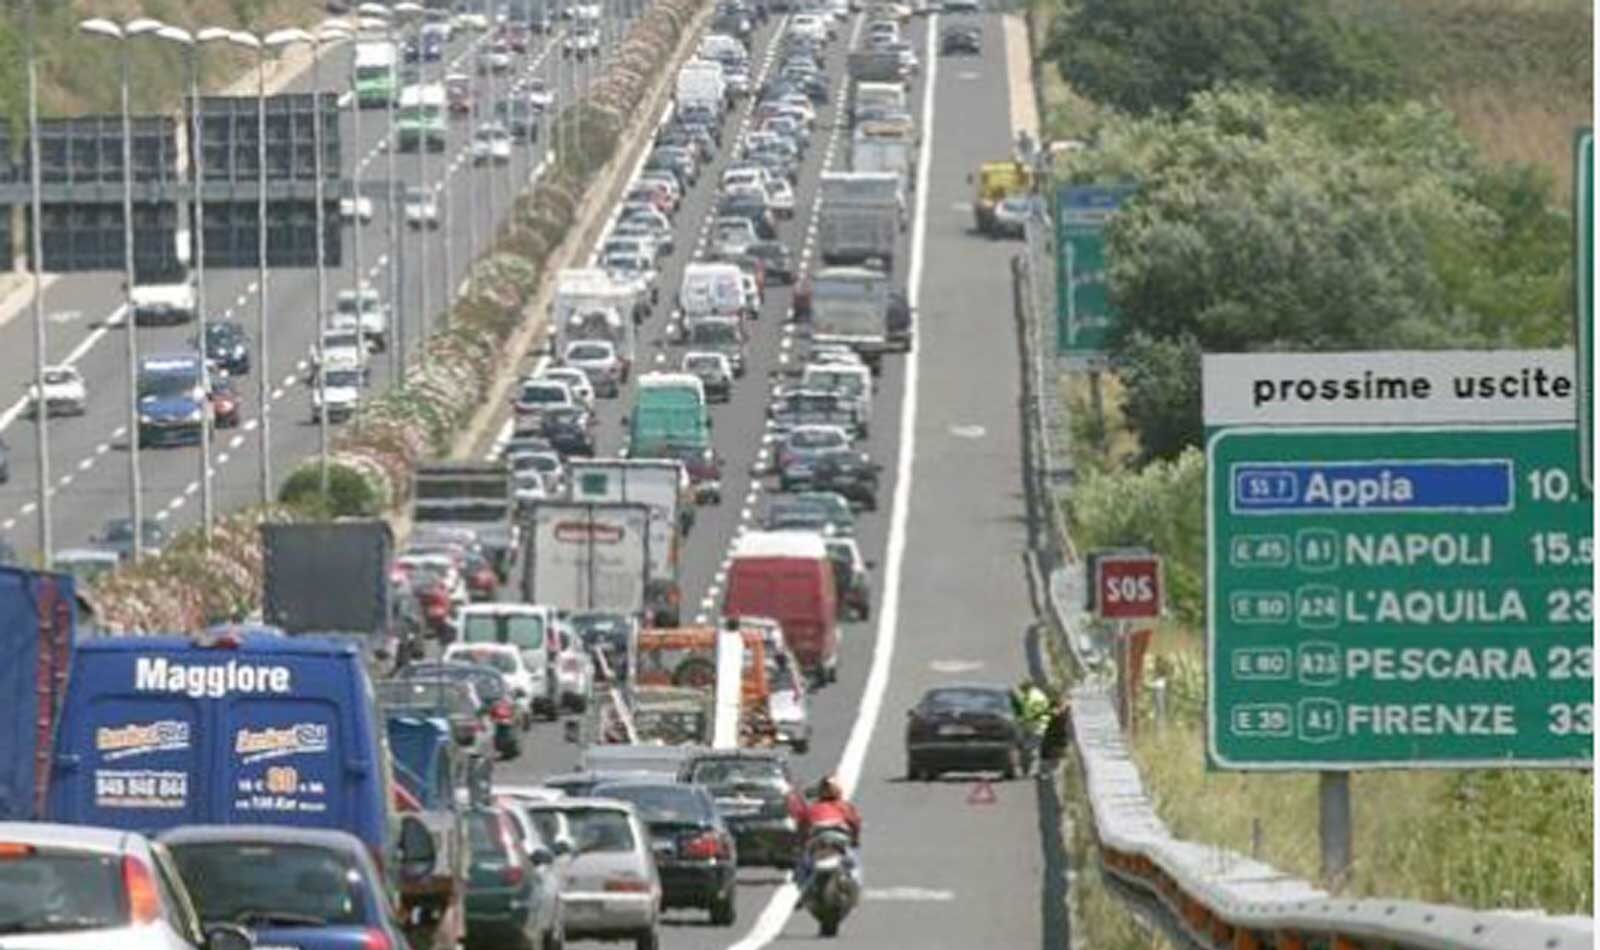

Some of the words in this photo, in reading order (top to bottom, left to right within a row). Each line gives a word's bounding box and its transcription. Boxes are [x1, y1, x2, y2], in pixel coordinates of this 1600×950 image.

[1252, 370, 1431, 407] prossime
[1453, 367, 1571, 399] uscite
[1303, 470, 1413, 507] Appia
[1305, 538, 1331, 561] A1
[1345, 533, 1492, 564] NAPOLI
[1106, 575, 1153, 602] SOS
[1345, 590, 1527, 623] L'AQUILA
[135, 657, 291, 698] Maggiore
[1346, 648, 1536, 680] PESCARA
[1237, 712, 1251, 729] E
[1308, 709, 1333, 730] A1
[1347, 705, 1517, 735] FIRENZE
